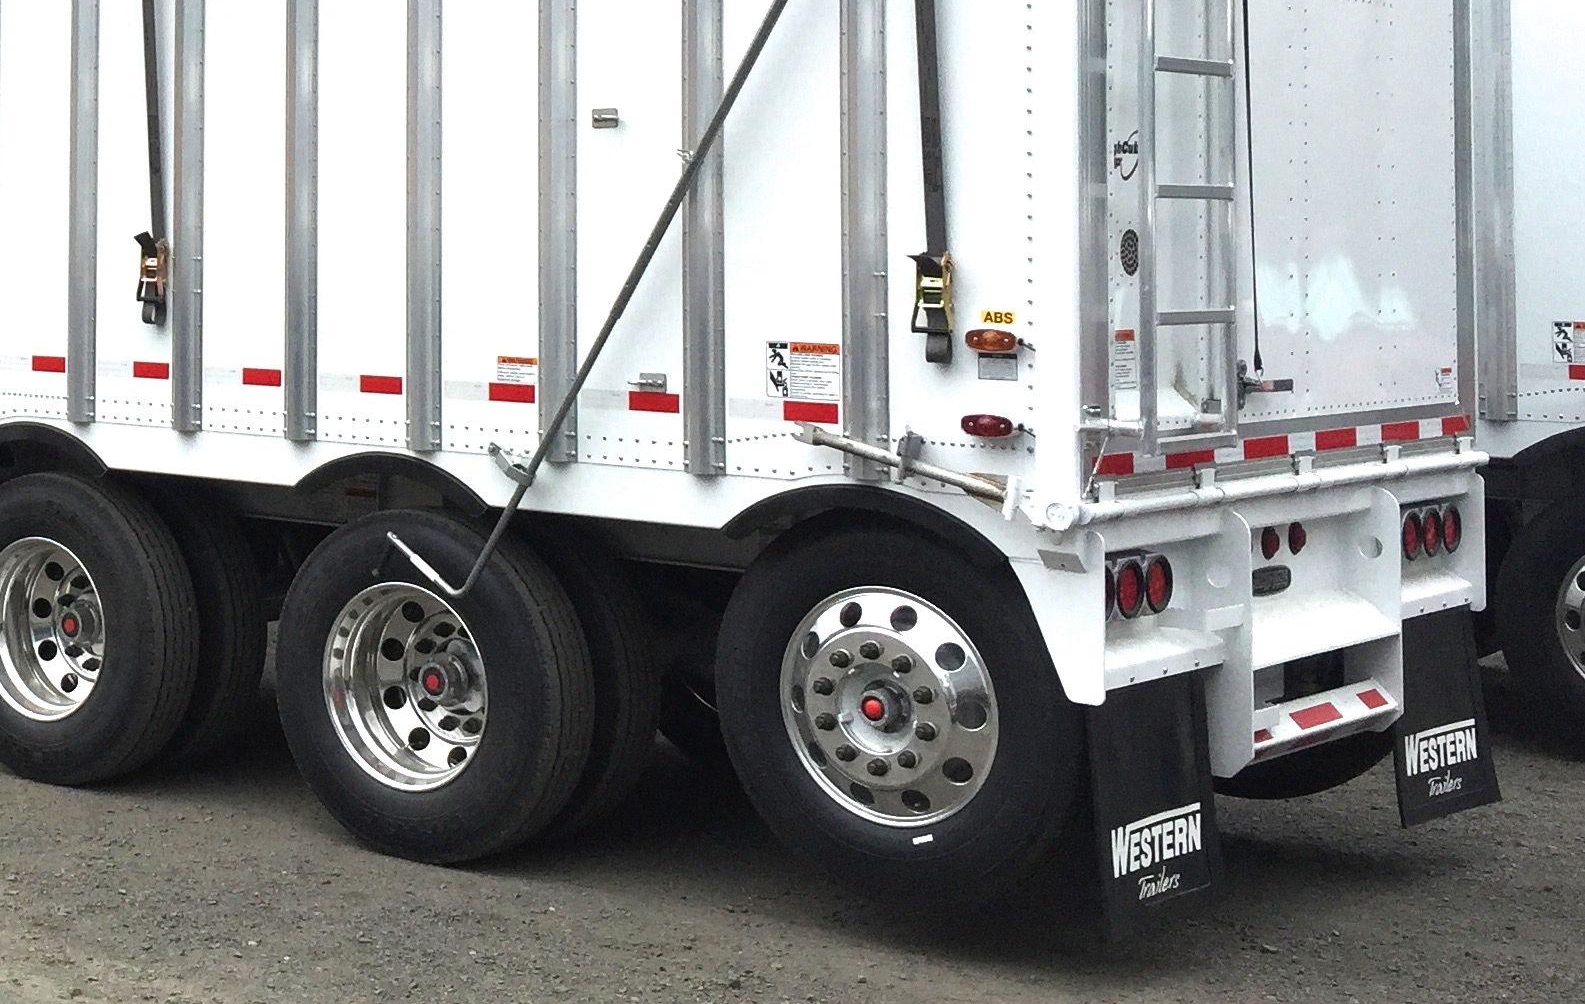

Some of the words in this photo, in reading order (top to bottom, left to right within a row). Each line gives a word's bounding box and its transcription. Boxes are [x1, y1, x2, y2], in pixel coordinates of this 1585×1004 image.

[984, 311, 1013, 324] ABS
[1404, 718, 1477, 776] WESTERN
[1428, 770, 1462, 796] Trailers
[1111, 802, 1202, 878] WESTERN
[1138, 866, 1180, 900] Trailers
